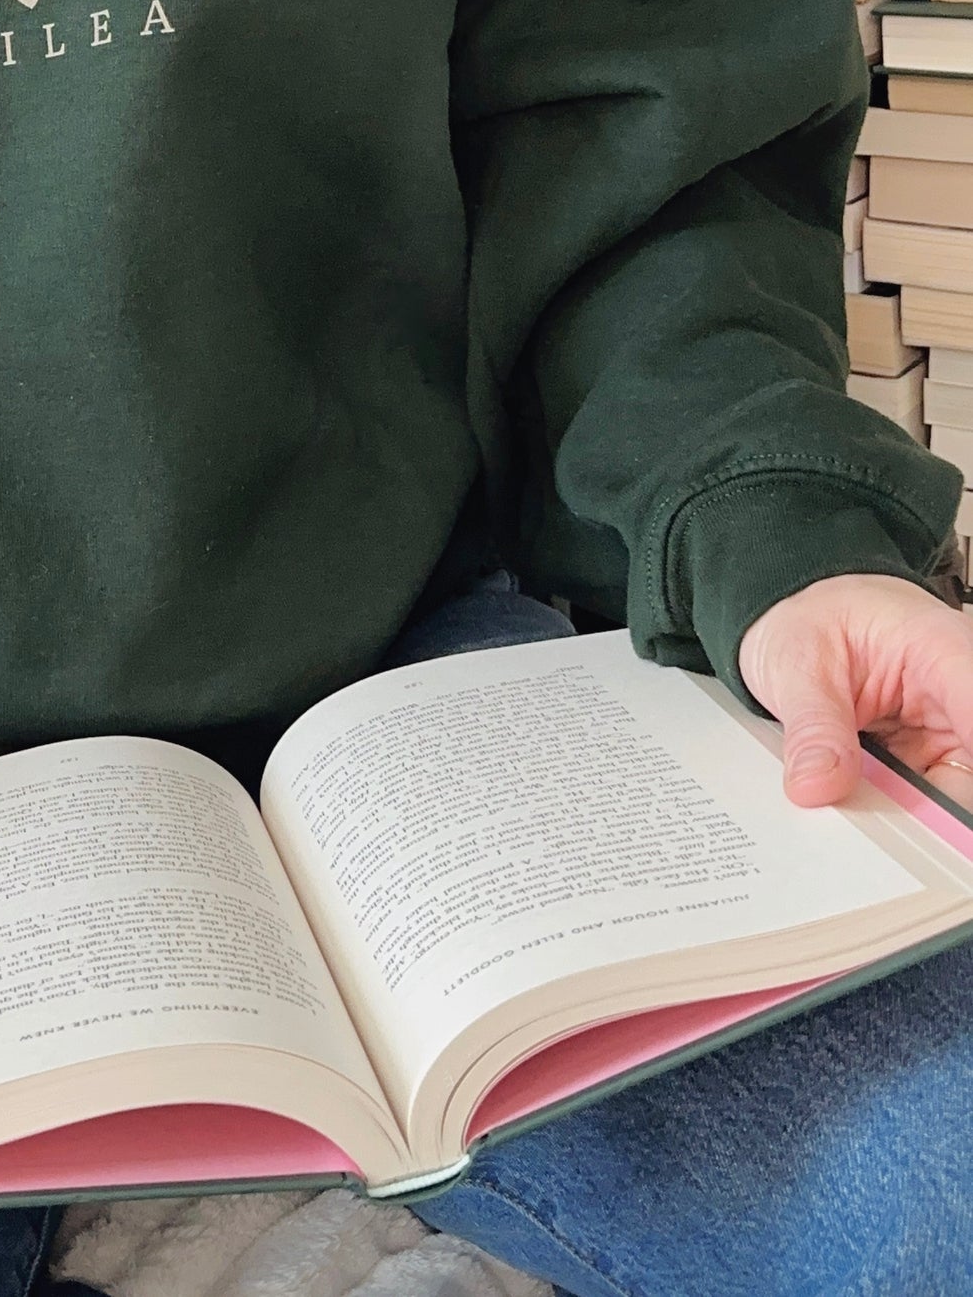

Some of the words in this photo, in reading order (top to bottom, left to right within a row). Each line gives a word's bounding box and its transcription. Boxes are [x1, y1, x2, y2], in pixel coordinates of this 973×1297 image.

[559, 855, 587, 864] they
[565, 858, 614, 871] happen
[525, 862, 554, 873] clear
[443, 862, 514, 896] professional
[523, 870, 560, 882] when
[654, 873, 680, 881] face
[470, 877, 500, 892] their
[532, 884, 575, 898] hasten
[444, 894, 480, 914] going
[466, 899, 494, 914] little
[540, 893, 573, 908] good
[676, 893, 750, 912] JULIANNE
[406, 896, 438, 921] healer
[611, 908, 669, 925] HOUGH
[570, 922, 603, 935] AND
[76, 940, 107, 950] right
[521, 931, 564, 951] ELLEN
[39, 947, 71, 960] hand
[57, 952, 84, 962] eyes
[89, 960, 136, 973] careful.
[115, 965, 177, 976] medicine
[442, 949, 514, 997] GOODLETT
[82, 973, 110, 983] kick
[90, 977, 135, 989] loudly.
[44, 980, 76, 992] since
[123, 983, 159, 992] floor.
[129, 1008, 154, 1017] WE
[161, 1004, 259, 1015] EVERYTHING
[72, 1012, 122, 1028] NEVER
[19, 1025, 65, 1042] KNEW
